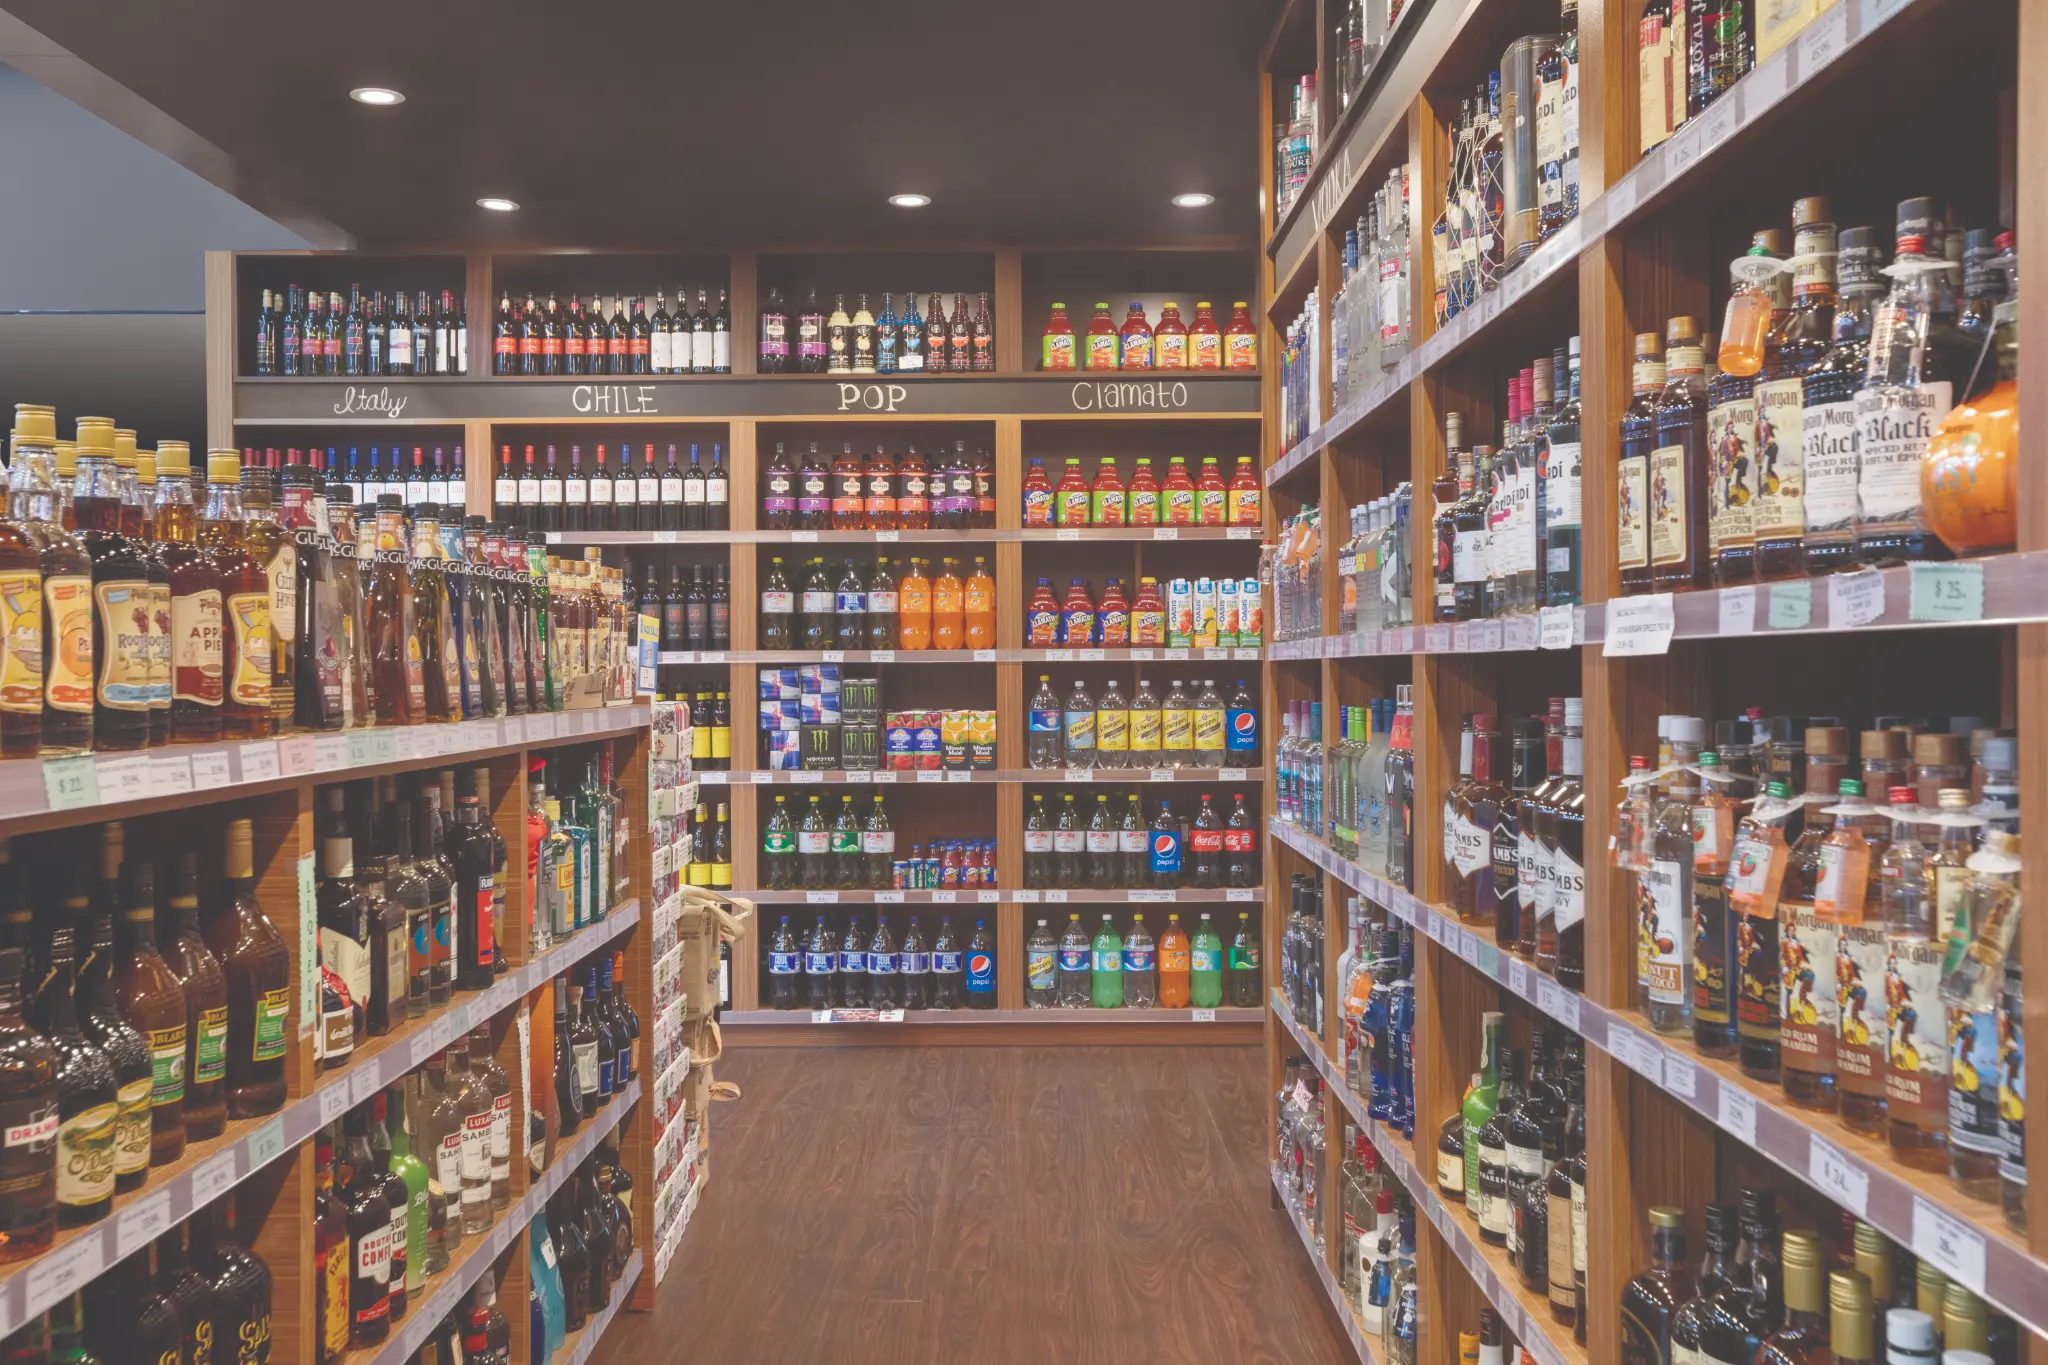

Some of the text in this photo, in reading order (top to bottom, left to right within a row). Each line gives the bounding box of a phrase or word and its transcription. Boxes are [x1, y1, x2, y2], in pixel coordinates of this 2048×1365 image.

[1691, 15, 1704, 74] ROYAL
[333, 386, 408, 418] Italy
[572, 385, 658, 413] CHILE
[836, 383, 907, 411] POP
[1072, 381, 1188, 410] Clamato
[1761, 387, 1798, 411] Morgan
[1865, 411, 1931, 443] Black
[1864, 444, 1900, 456] SPICED
[1865, 455, 1894, 466] RHUM
[1031, 615, 1055, 628] CLAMATO
[1067, 615, 1091, 628] CLAMATO
[1103, 615, 1127, 628] CLAMATO
[1138, 615, 1161, 628] CLAMATO
[204, 639, 221, 651] PIE
[1099, 718, 1124, 733] Schweppes
[1134, 718, 1160, 733] Schweppes
[1236, 736, 1254, 744] pepsi
[1156, 859, 1175, 867] pepsi
[972, 978, 990, 986] pepsi
[1792, 1032, 1818, 1045] RUM
[1847, 1052, 1871, 1066] RUM
[1897, 1077, 1921, 1094] RUM
